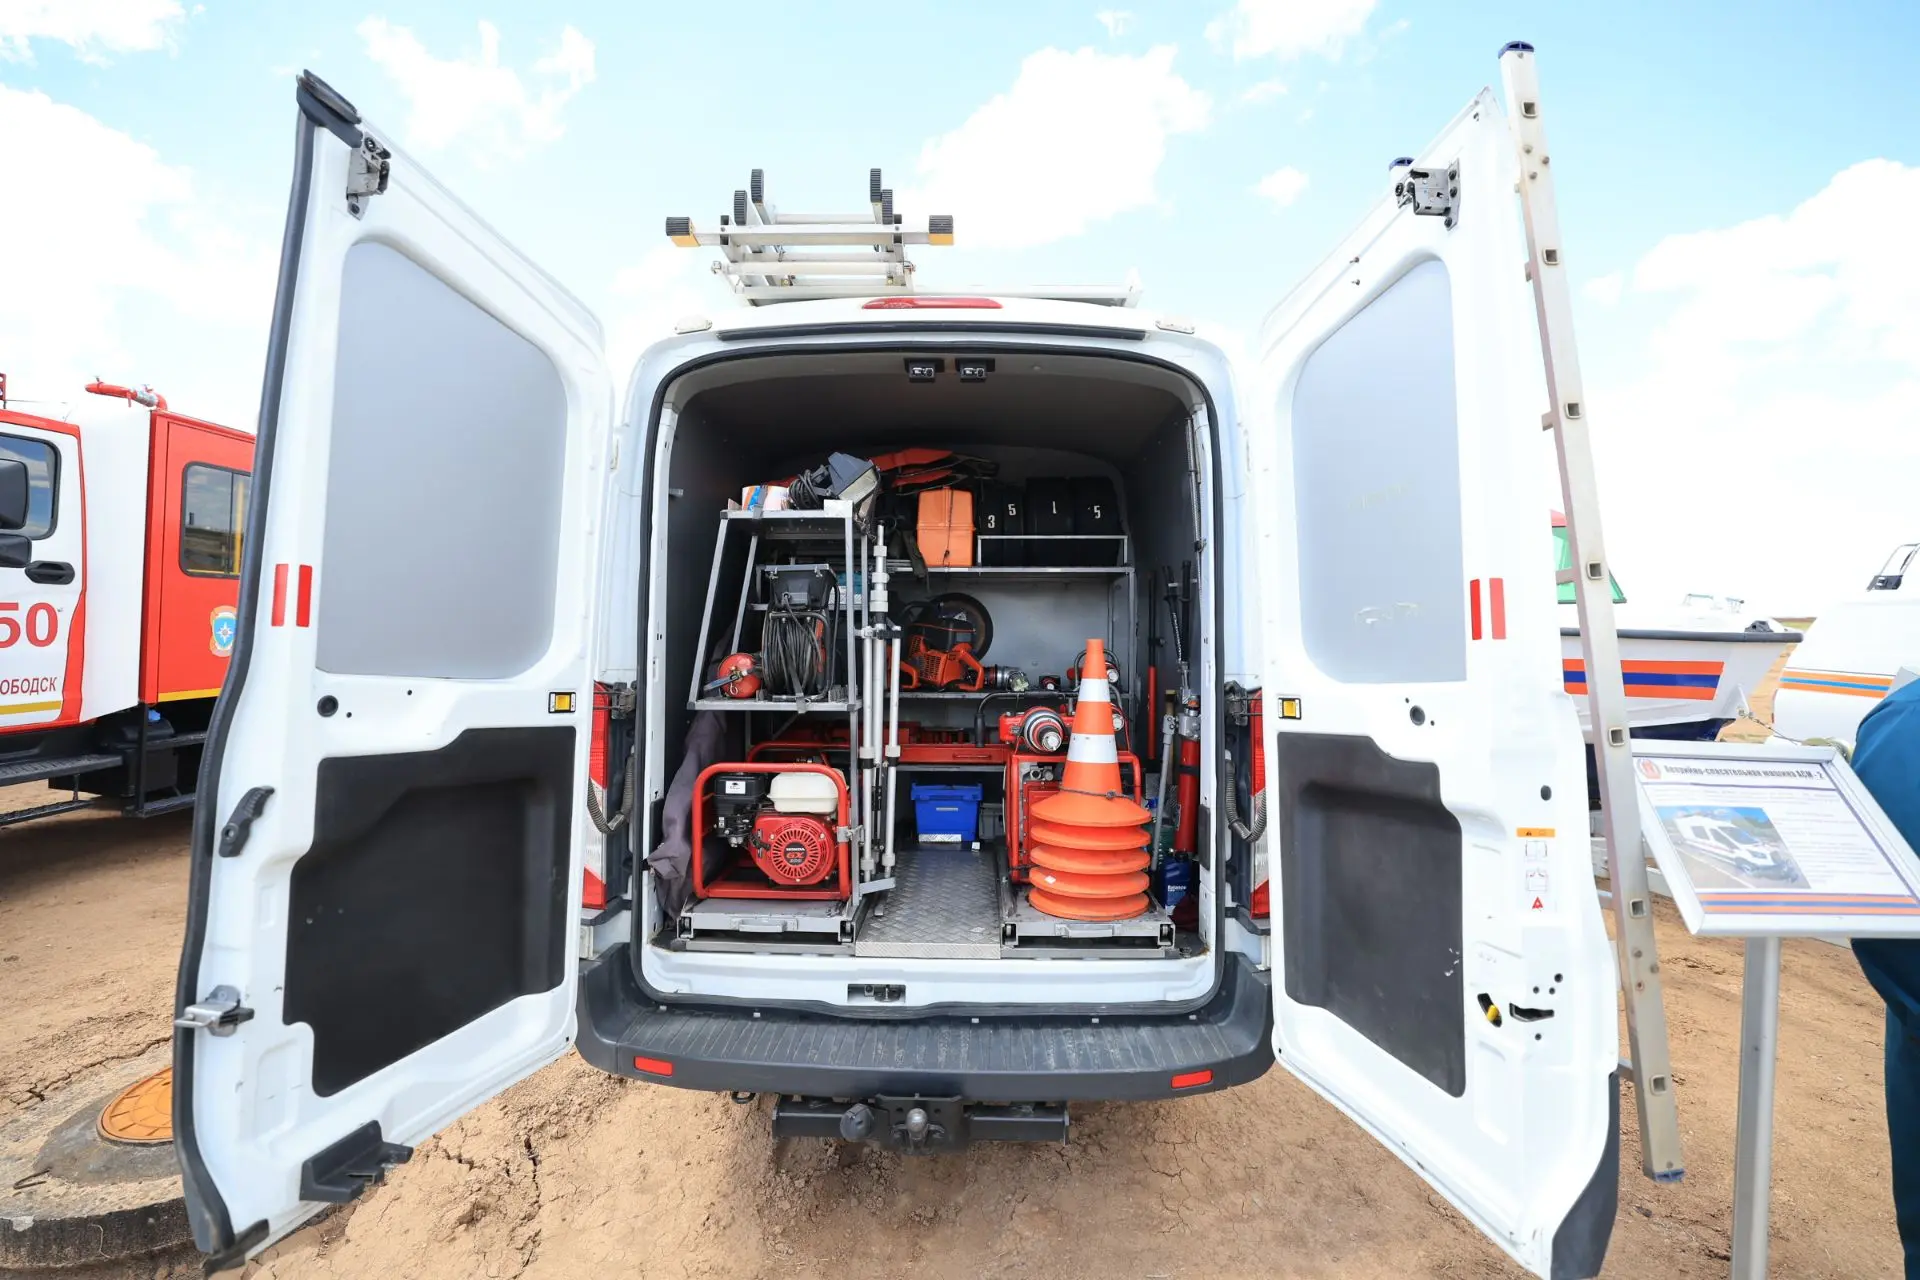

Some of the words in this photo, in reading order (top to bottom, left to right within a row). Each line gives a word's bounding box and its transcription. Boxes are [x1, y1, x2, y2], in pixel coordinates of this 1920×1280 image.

[1008, 503, 1017, 516] 5
[1094, 505, 1101, 519] 5
[988, 514, 996, 529] 3
